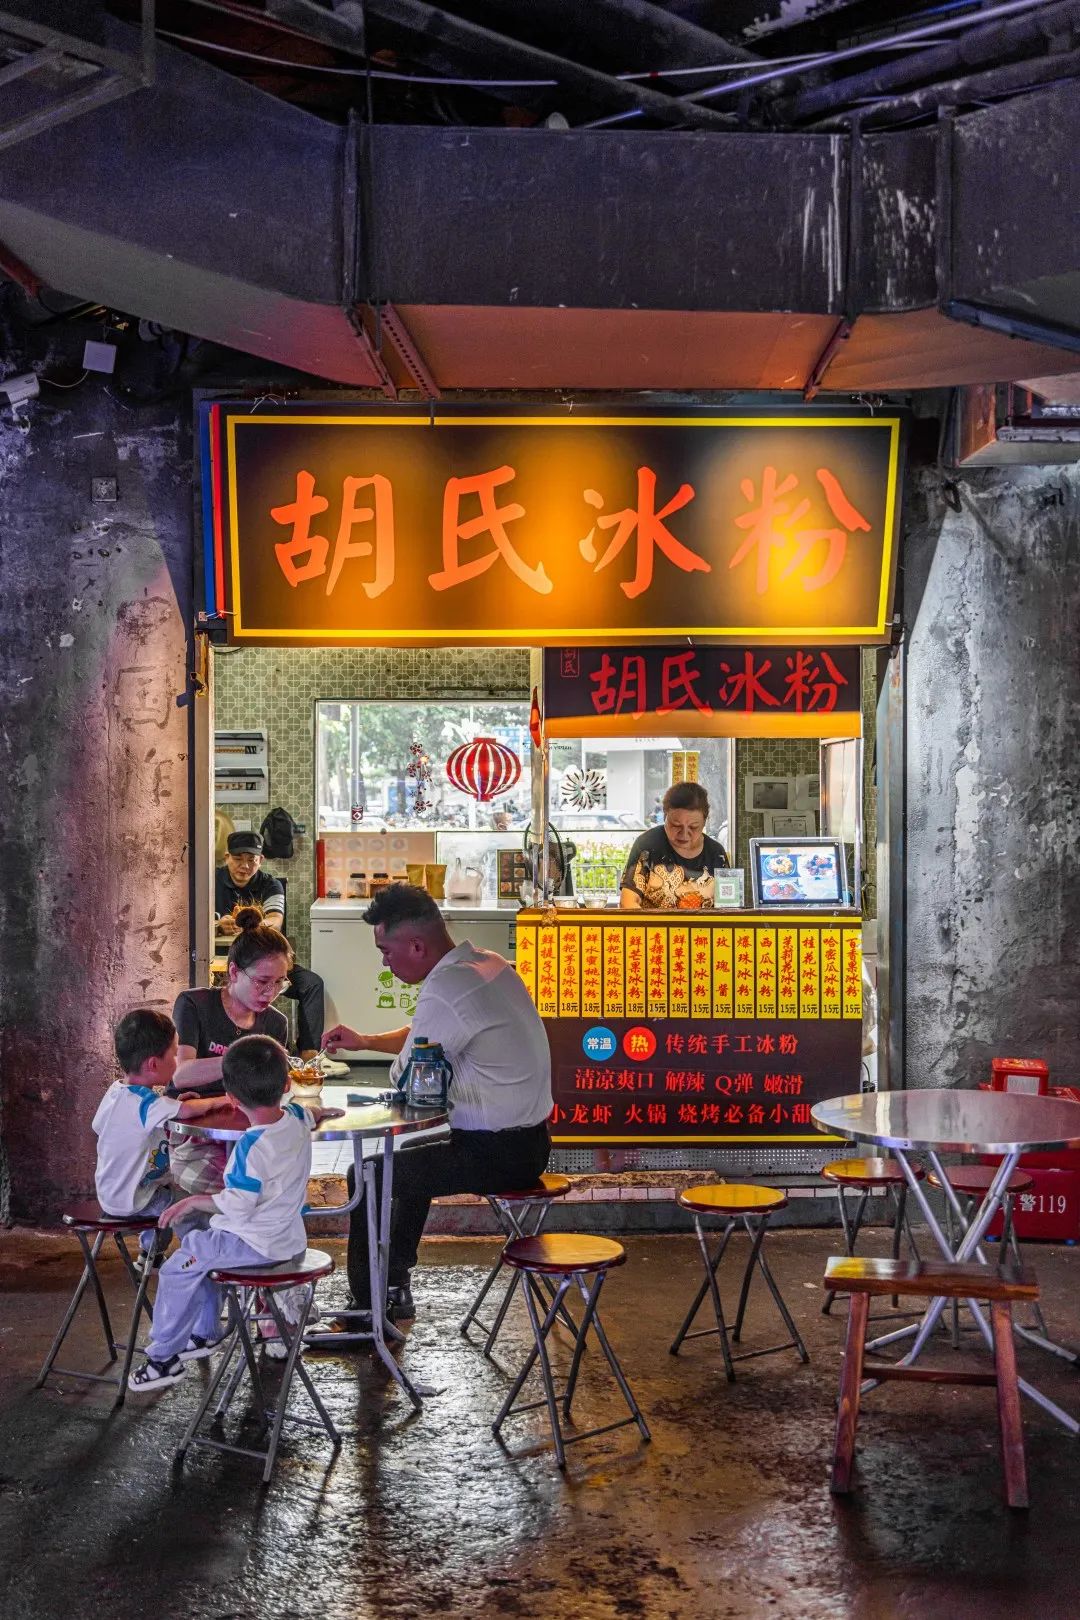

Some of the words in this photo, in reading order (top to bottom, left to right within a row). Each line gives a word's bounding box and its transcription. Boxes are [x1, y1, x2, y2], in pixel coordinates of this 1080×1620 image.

[271, 465, 872, 599] 胡氏冰粉
[589, 650, 849, 720] 胡氏冰粉
[518, 937, 536, 996] 全家
[584, 933, 600, 998] 鲜水蜜桃冰粉
[627, 936, 643, 998] 鲜芒果冰粉
[672, 934, 687, 998] 鲜草莓冰粉
[693, 935, 708, 997] 椰果冰粉
[737, 935, 752, 997] 爆珠冰粉
[759, 936, 774, 997] 西瓜冰粉
[781, 935, 796, 997] 茉莉花冰粉
[802, 936, 817, 997] 桂花冰粉
[823, 936, 838, 998] 哈密瓜冰粉
[845, 937, 860, 998] 百香果冰粉
[540, 1002, 556, 1013] 18元
[562, 1002, 578, 1013] 18元
[584, 1002, 600, 1013] 18元
[606, 1003, 622, 1013] 18元
[628, 1002, 643, 1013] 18元
[650, 1002, 666, 1013] 15元
[672, 1003, 687, 1013] 18元
[694, 1003, 709, 1014] 15元
[715, 1003, 731, 1014] 15元
[737, 1003, 753, 1014] 15元
[759, 1003, 774, 1014] 15元
[781, 1003, 796, 1014] 15元
[803, 1003, 818, 1014] 15元
[823, 1003, 839, 1014] 15元
[845, 1003, 861, 1014] 15元
[587, 1037, 612, 1051] 常温
[630, 1035, 649, 1053] 热
[665, 1034, 798, 1054] 传统手工冰粉
[575, 1068, 654, 1090] 清凉爽口
[665, 1070, 705, 1092] 解辣
[715, 1073, 753, 1096] Q弹
[763, 1074, 804, 1096] 嫩滑
[550, 1103, 612, 1124] 小龙虾
[625, 1103, 667, 1124] 火锅
